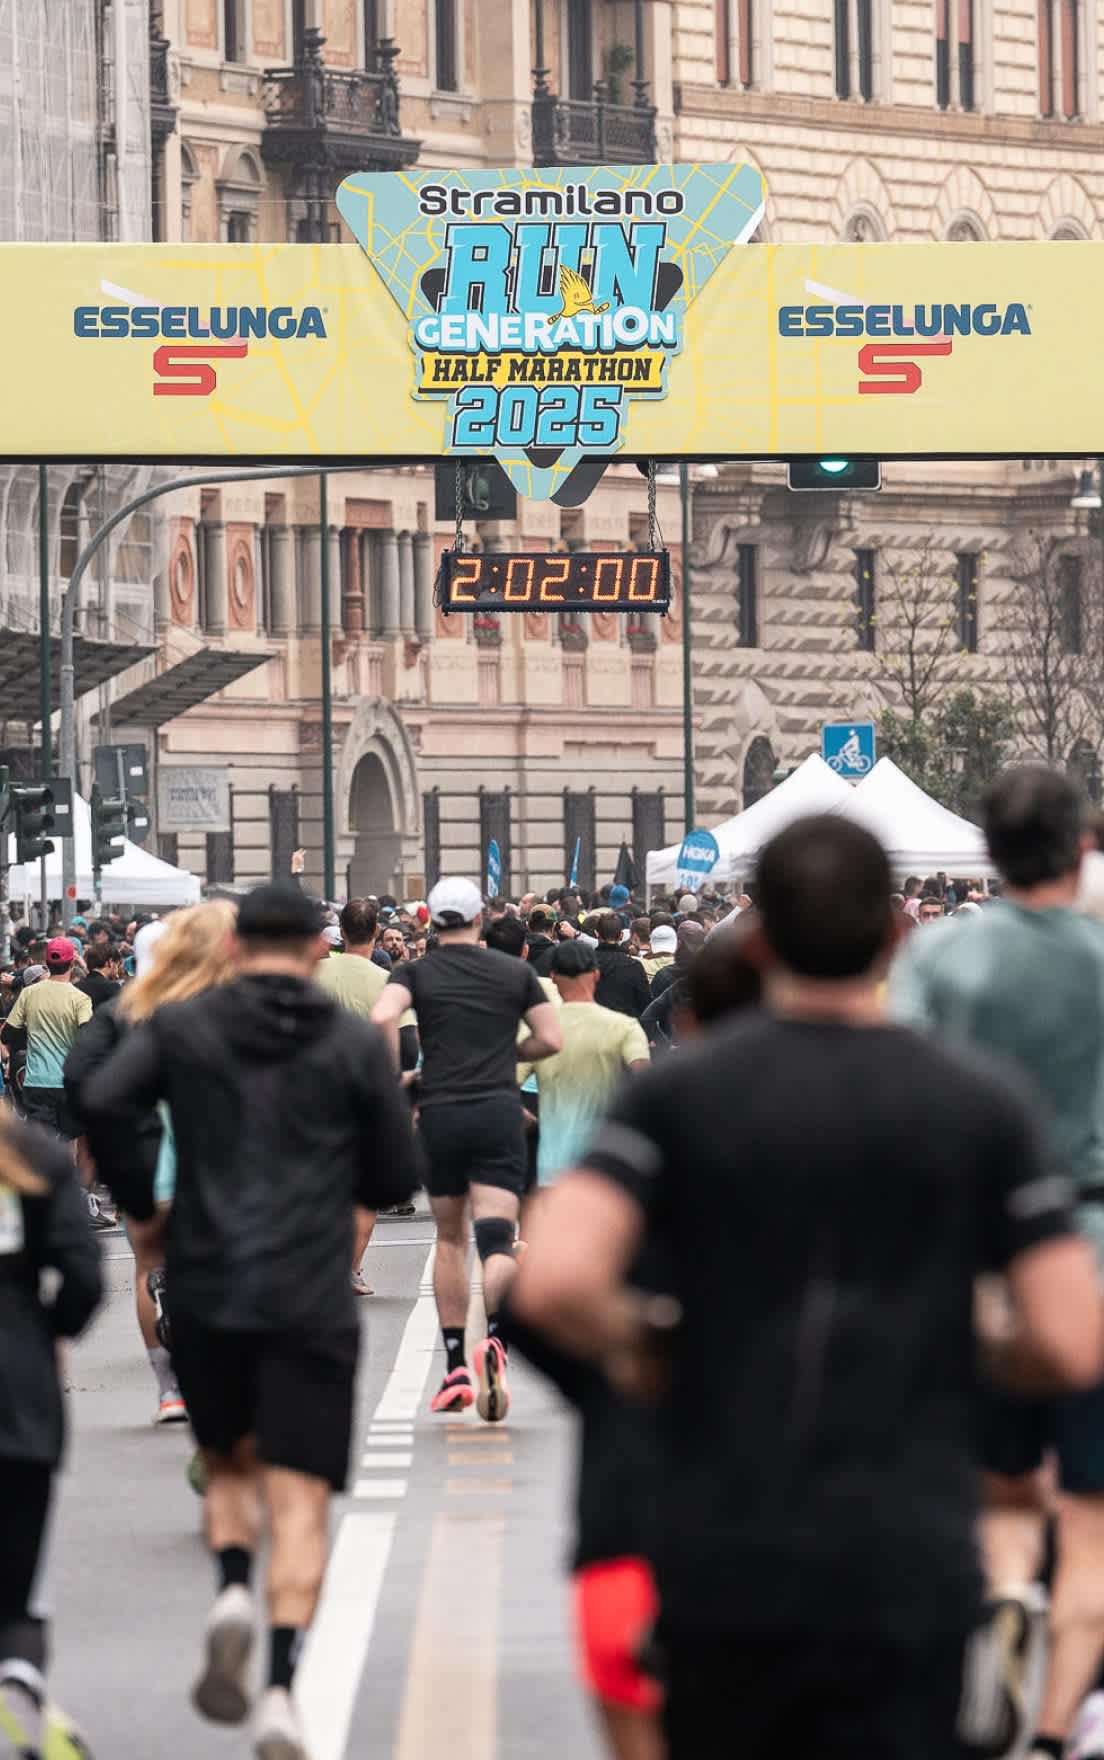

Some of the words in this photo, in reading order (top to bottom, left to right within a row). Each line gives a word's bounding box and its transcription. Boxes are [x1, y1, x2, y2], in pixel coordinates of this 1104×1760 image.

[419, 185, 684, 215] Stramilano
[438, 222, 667, 314] RUN
[74, 306, 327, 338] ESSELUNGA
[416, 306, 677, 349] GENERATION
[778, 303, 1032, 336] ESSELUNGA
[432, 358, 501, 382] HALF
[508, 357, 652, 381] MARATHON
[452, 384, 623, 447] 2025
[450, 558, 659, 601] 2:02:00
